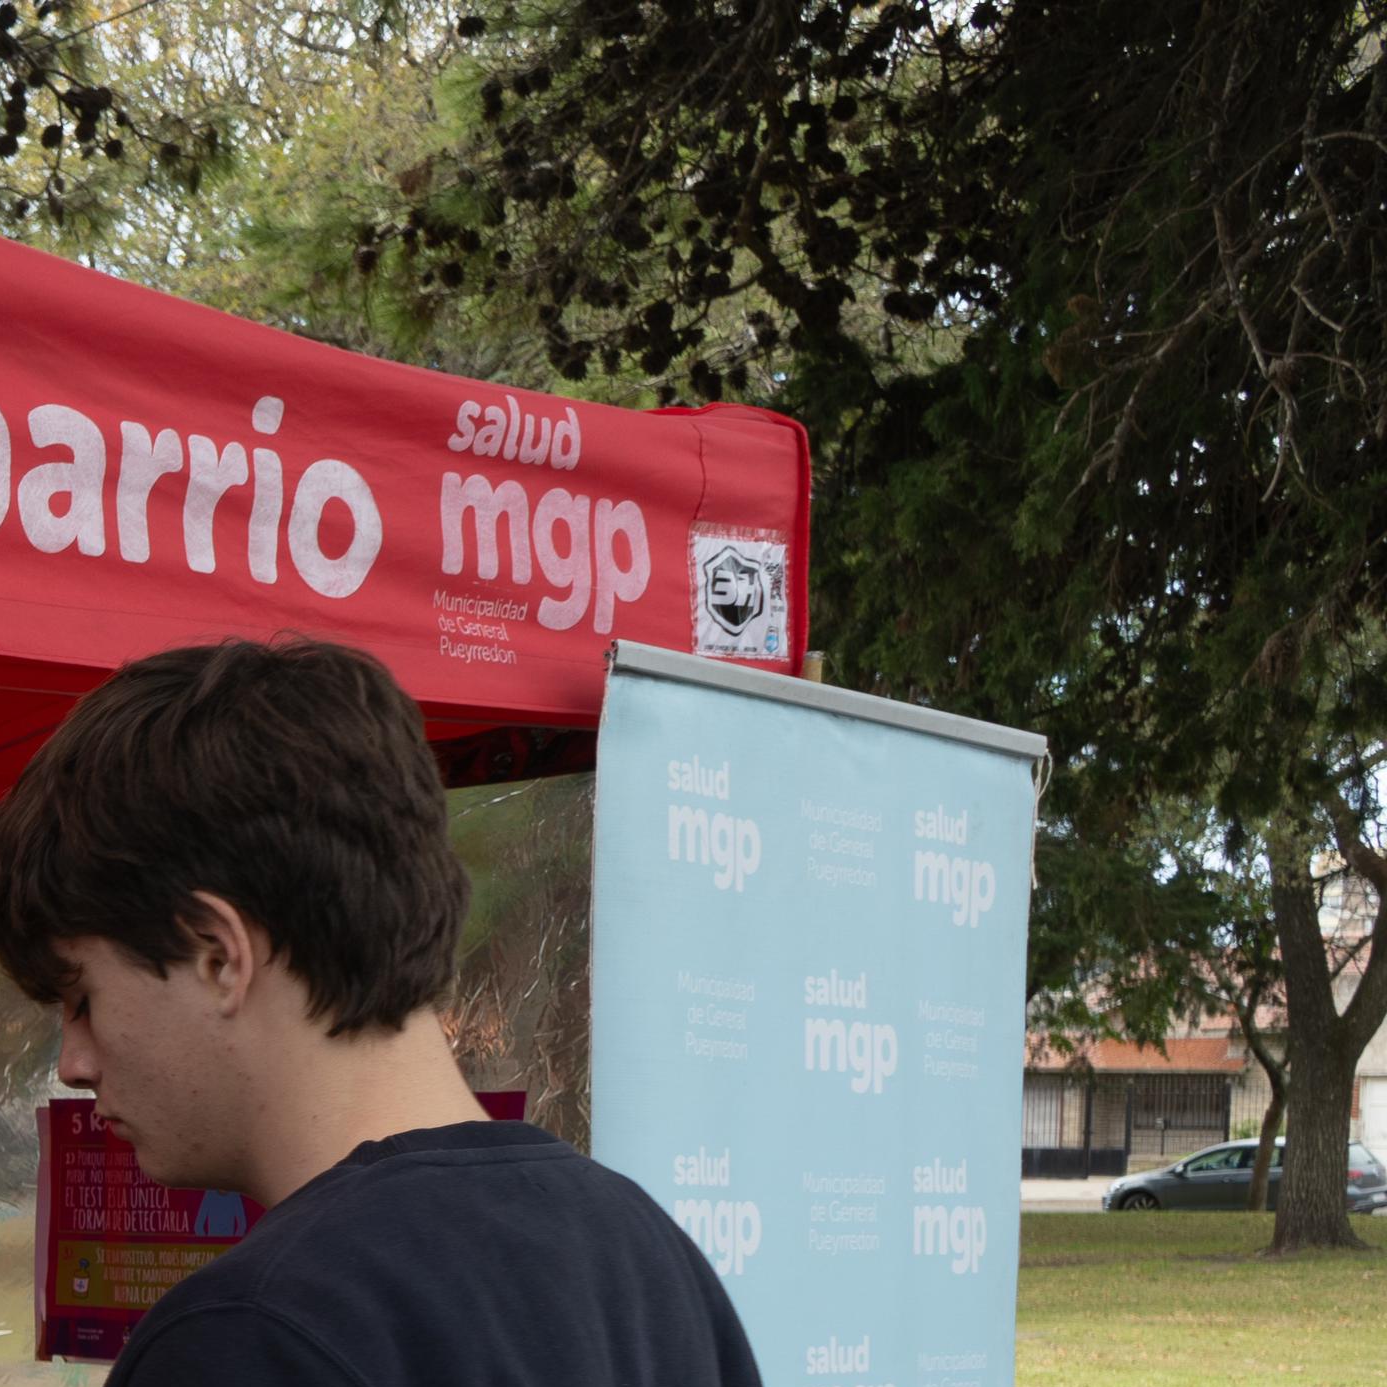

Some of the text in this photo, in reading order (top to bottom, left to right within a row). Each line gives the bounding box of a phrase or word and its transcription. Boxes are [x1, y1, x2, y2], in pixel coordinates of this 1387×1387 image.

[447, 394, 582, 471] salud
[440, 471, 651, 634] mgp
[433, 588, 529, 622] Municipalidad
[438, 613, 510, 642] de General
[440, 635, 518, 665] Pueyrredon
[668, 754, 730, 801] salud
[915, 804, 969, 847] salud
[667, 803, 761, 892] mgp
[914, 848, 995, 928] mgp
[804, 968, 867, 1009] salud
[805, 1016, 898, 1095] mgp
[72, 1113, 83, 1134] 5
[90, 1170, 104, 1183] NO
[673, 1146, 730, 1187] salud
[913, 1157, 967, 1195] salud
[65, 1186, 75, 1207] EL
[78, 1186, 104, 1207] TEST
[130, 1184, 170, 1209] ÚNICA
[73, 1209, 112, 1230] FORMA
[123, 1209, 190, 1233] DETECTARLA
[674, 1200, 762, 1276] mgp
[913, 1203, 987, 1275] mgp
[806, 1334, 870, 1377] salud
